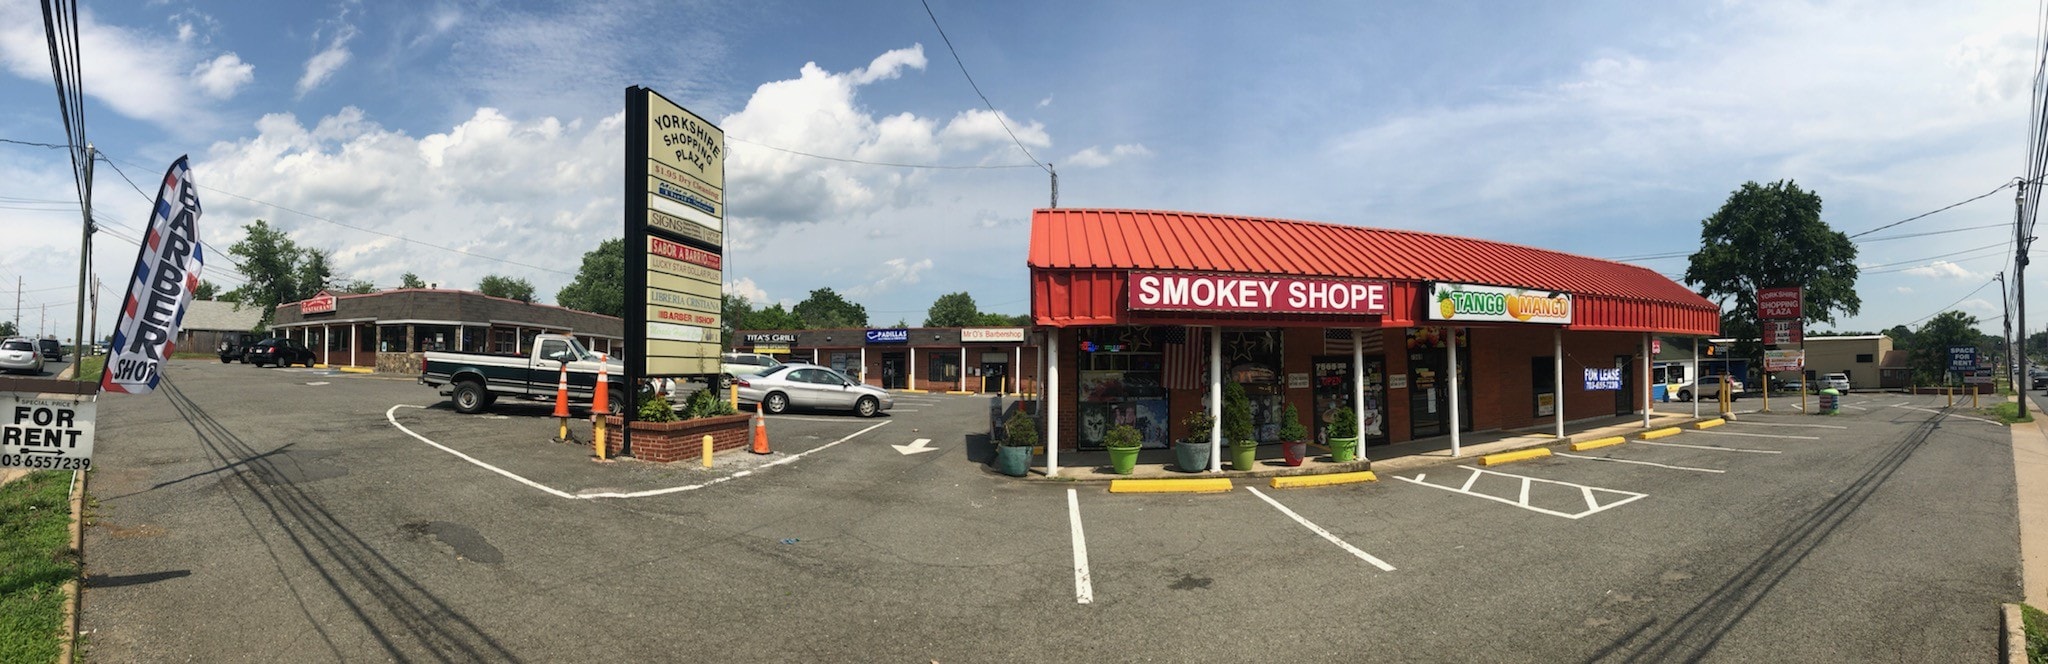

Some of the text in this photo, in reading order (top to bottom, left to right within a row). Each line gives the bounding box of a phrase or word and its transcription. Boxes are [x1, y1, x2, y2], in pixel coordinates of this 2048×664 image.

[654, 115, 720, 158] YORKSHIRE
[663, 133, 713, 165] SHOPPING
[675, 149, 704, 173] PLAZA
[655, 165, 720, 200] $1.95 Dry Cleaning
[652, 212, 683, 232] SIGNS
[653, 239, 677, 258] SABOR
[678, 248, 684, 260] A
[685, 249, 708, 265] BARRIO
[130, 178, 196, 361] BARBER
[653, 259, 672, 270] LUCKY
[672, 263, 687, 272] STAR
[687, 266, 707, 278] DOLLAR
[652, 291, 720, 311] LIBRERIA CRISTIANA
[1139, 276, 1385, 310] SMOKEY SHOPE
[1760, 291, 1798, 300] YORKSHIRE
[1451, 291, 1568, 318] TANGO MANGO
[1760, 300, 1798, 309] SHOPPING
[1766, 308, 1791, 316] PLAZA
[660, 311, 715, 325] BARBER SHOP
[772, 333, 796, 341] GRILL
[877, 330, 907, 338] PADILLAS
[985, 330, 1022, 339] Barbershop
[114, 356, 158, 383] SHOP
[1584, 368, 1620, 381] FOR LEASE
[14, 406, 75, 428] FOR
[2, 426, 82, 448] RENT
